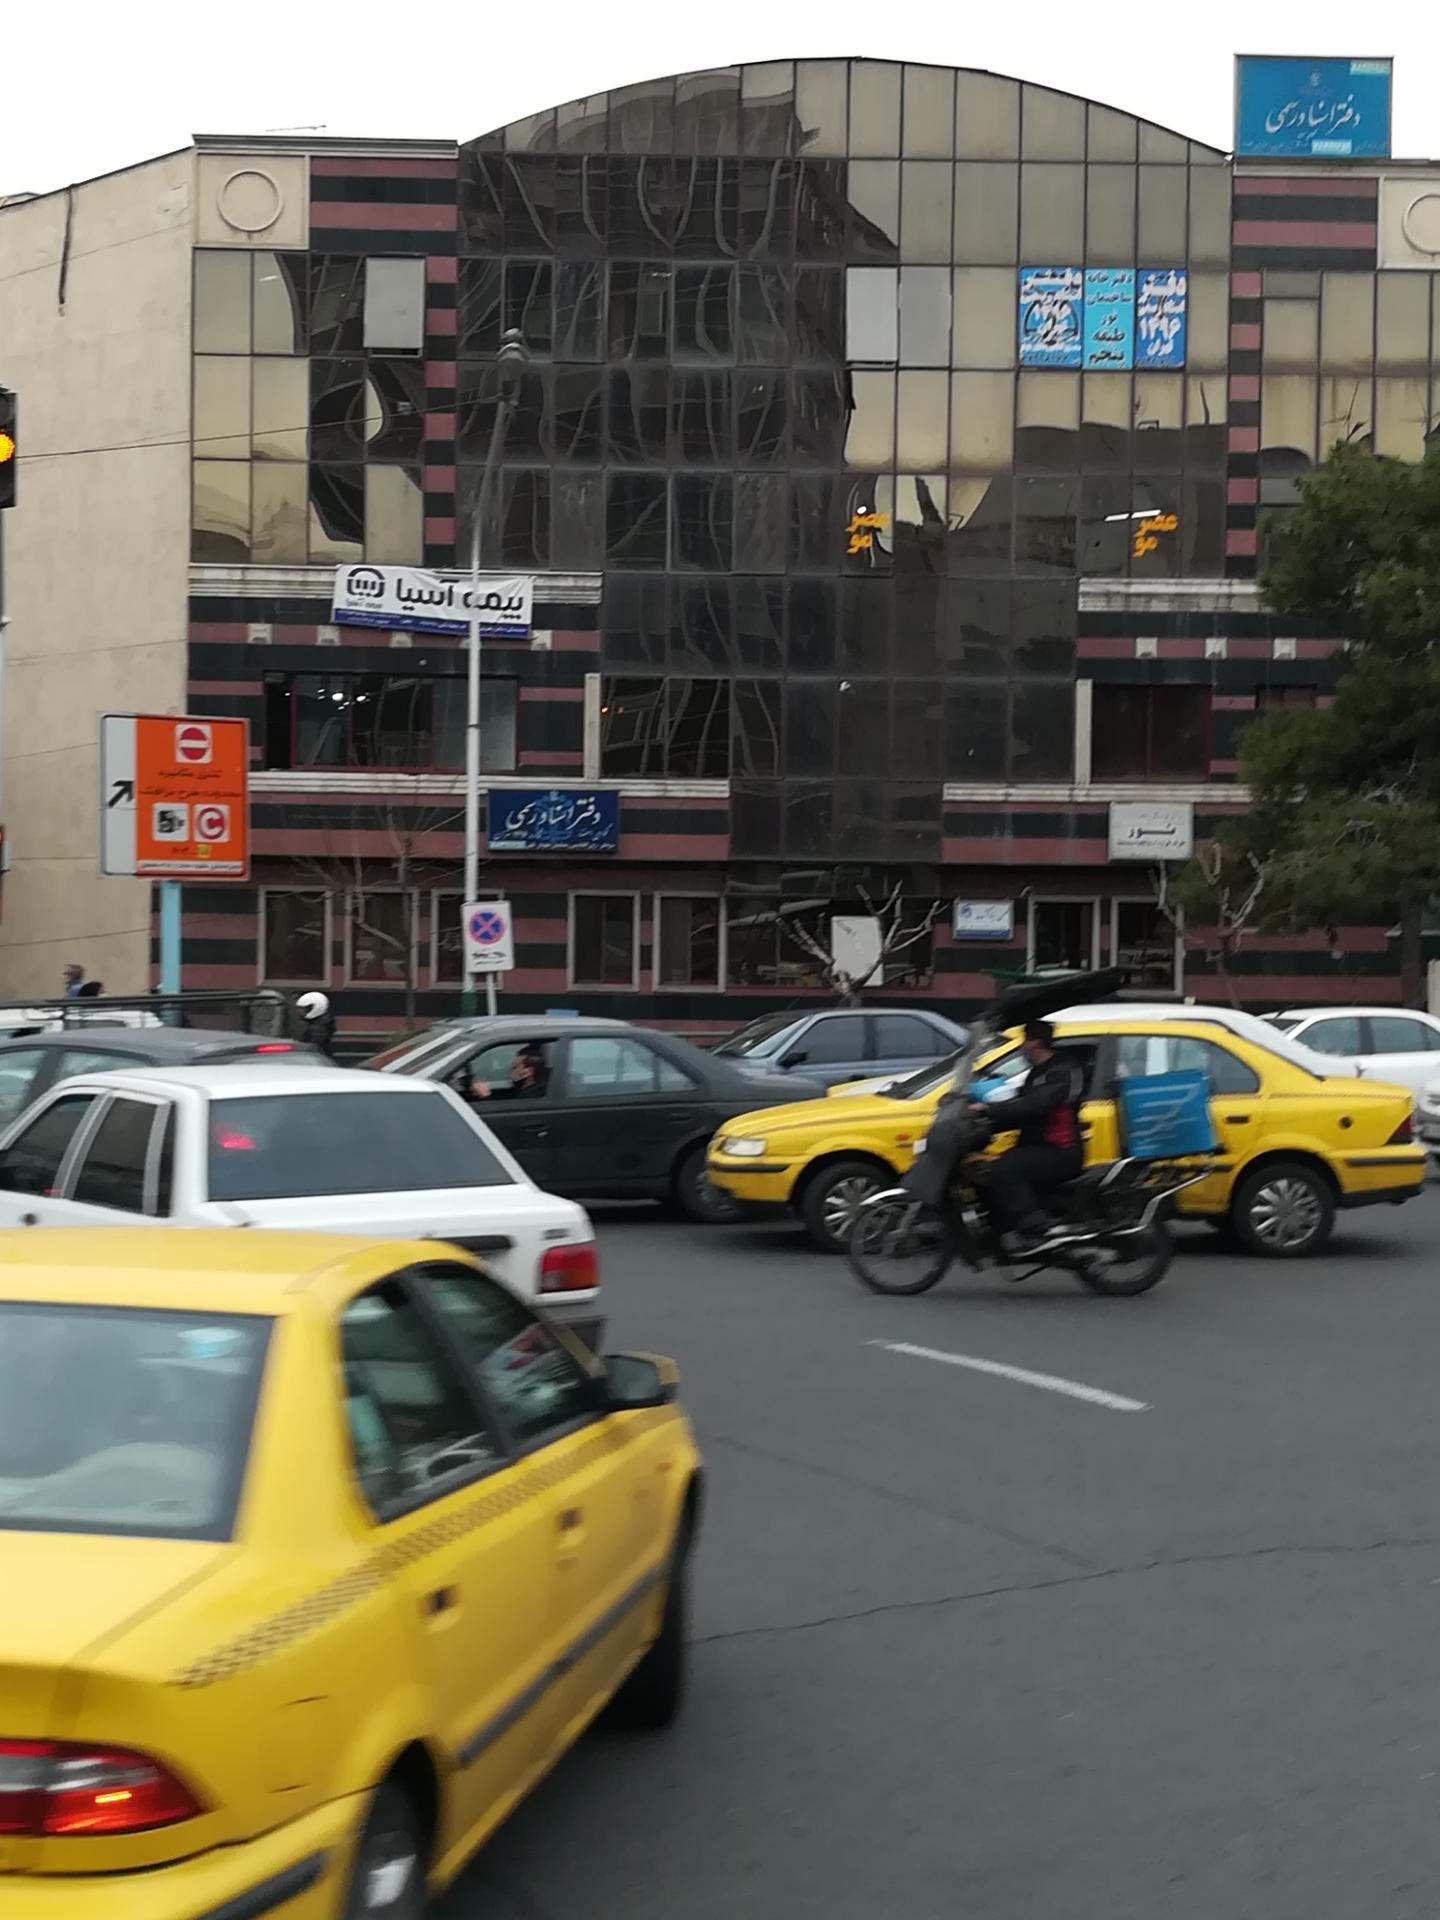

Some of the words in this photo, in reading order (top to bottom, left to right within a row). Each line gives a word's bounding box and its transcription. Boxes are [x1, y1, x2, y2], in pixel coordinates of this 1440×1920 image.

[1265, 100, 1299, 134] رسمی
[1326, 94, 1361, 135] دفتر
[396, 578, 460, 611] آسیا
[505, 802, 537, 830] رسمی
[567, 796, 602, 830] دفتر
[1128, 823, 1177, 839] نور
